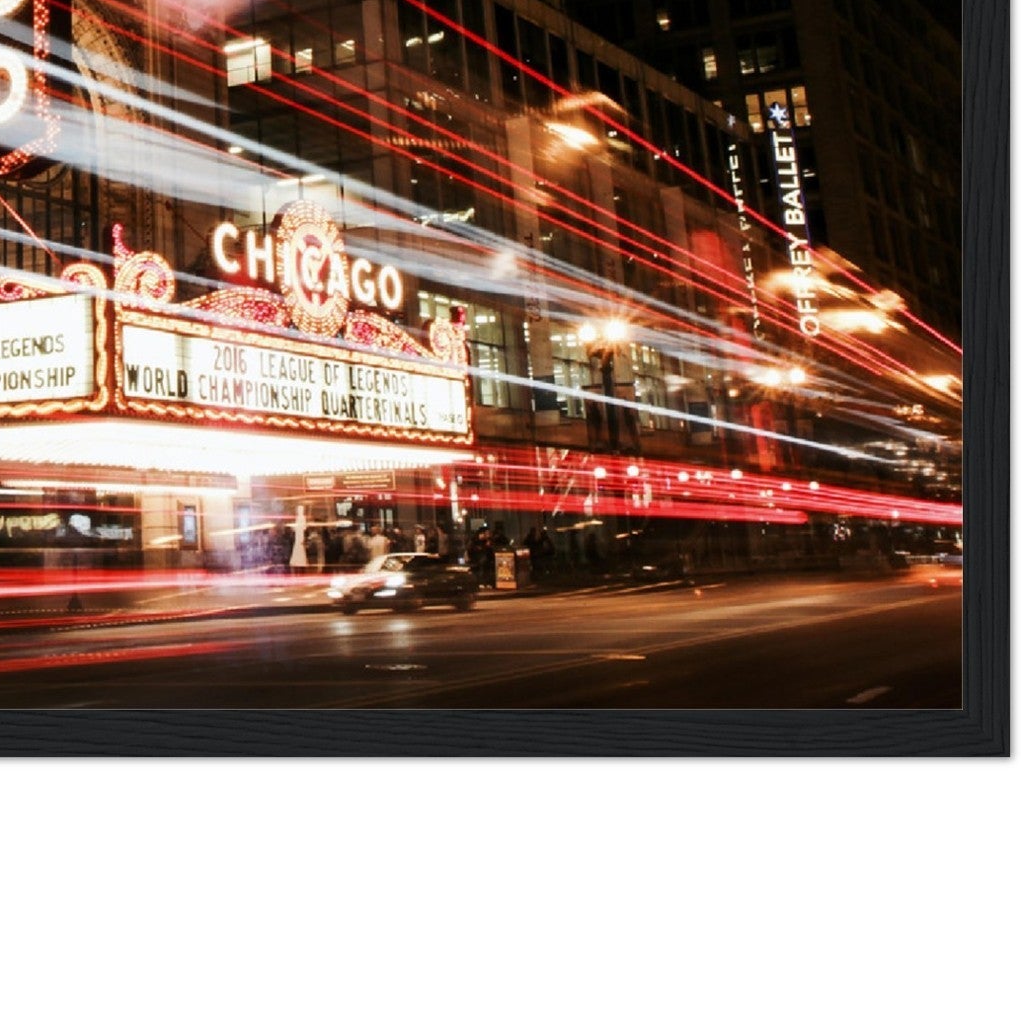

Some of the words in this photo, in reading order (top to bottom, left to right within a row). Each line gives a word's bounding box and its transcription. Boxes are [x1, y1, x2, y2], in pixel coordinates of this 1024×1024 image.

[772, 131, 806, 226] BALLET
[212, 222, 403, 310] CHICAGO
[125, 363, 189, 398] WORLD
[198, 374, 312, 413] CHAMPIONSHIP
[321, 391, 427, 426] QUARTERFINALS
[213, 345, 248, 375] 2016
[260, 351, 316, 385] LEAGUE
[324, 362, 340, 387] OF
[349, 366, 408, 397] LEGENDS
